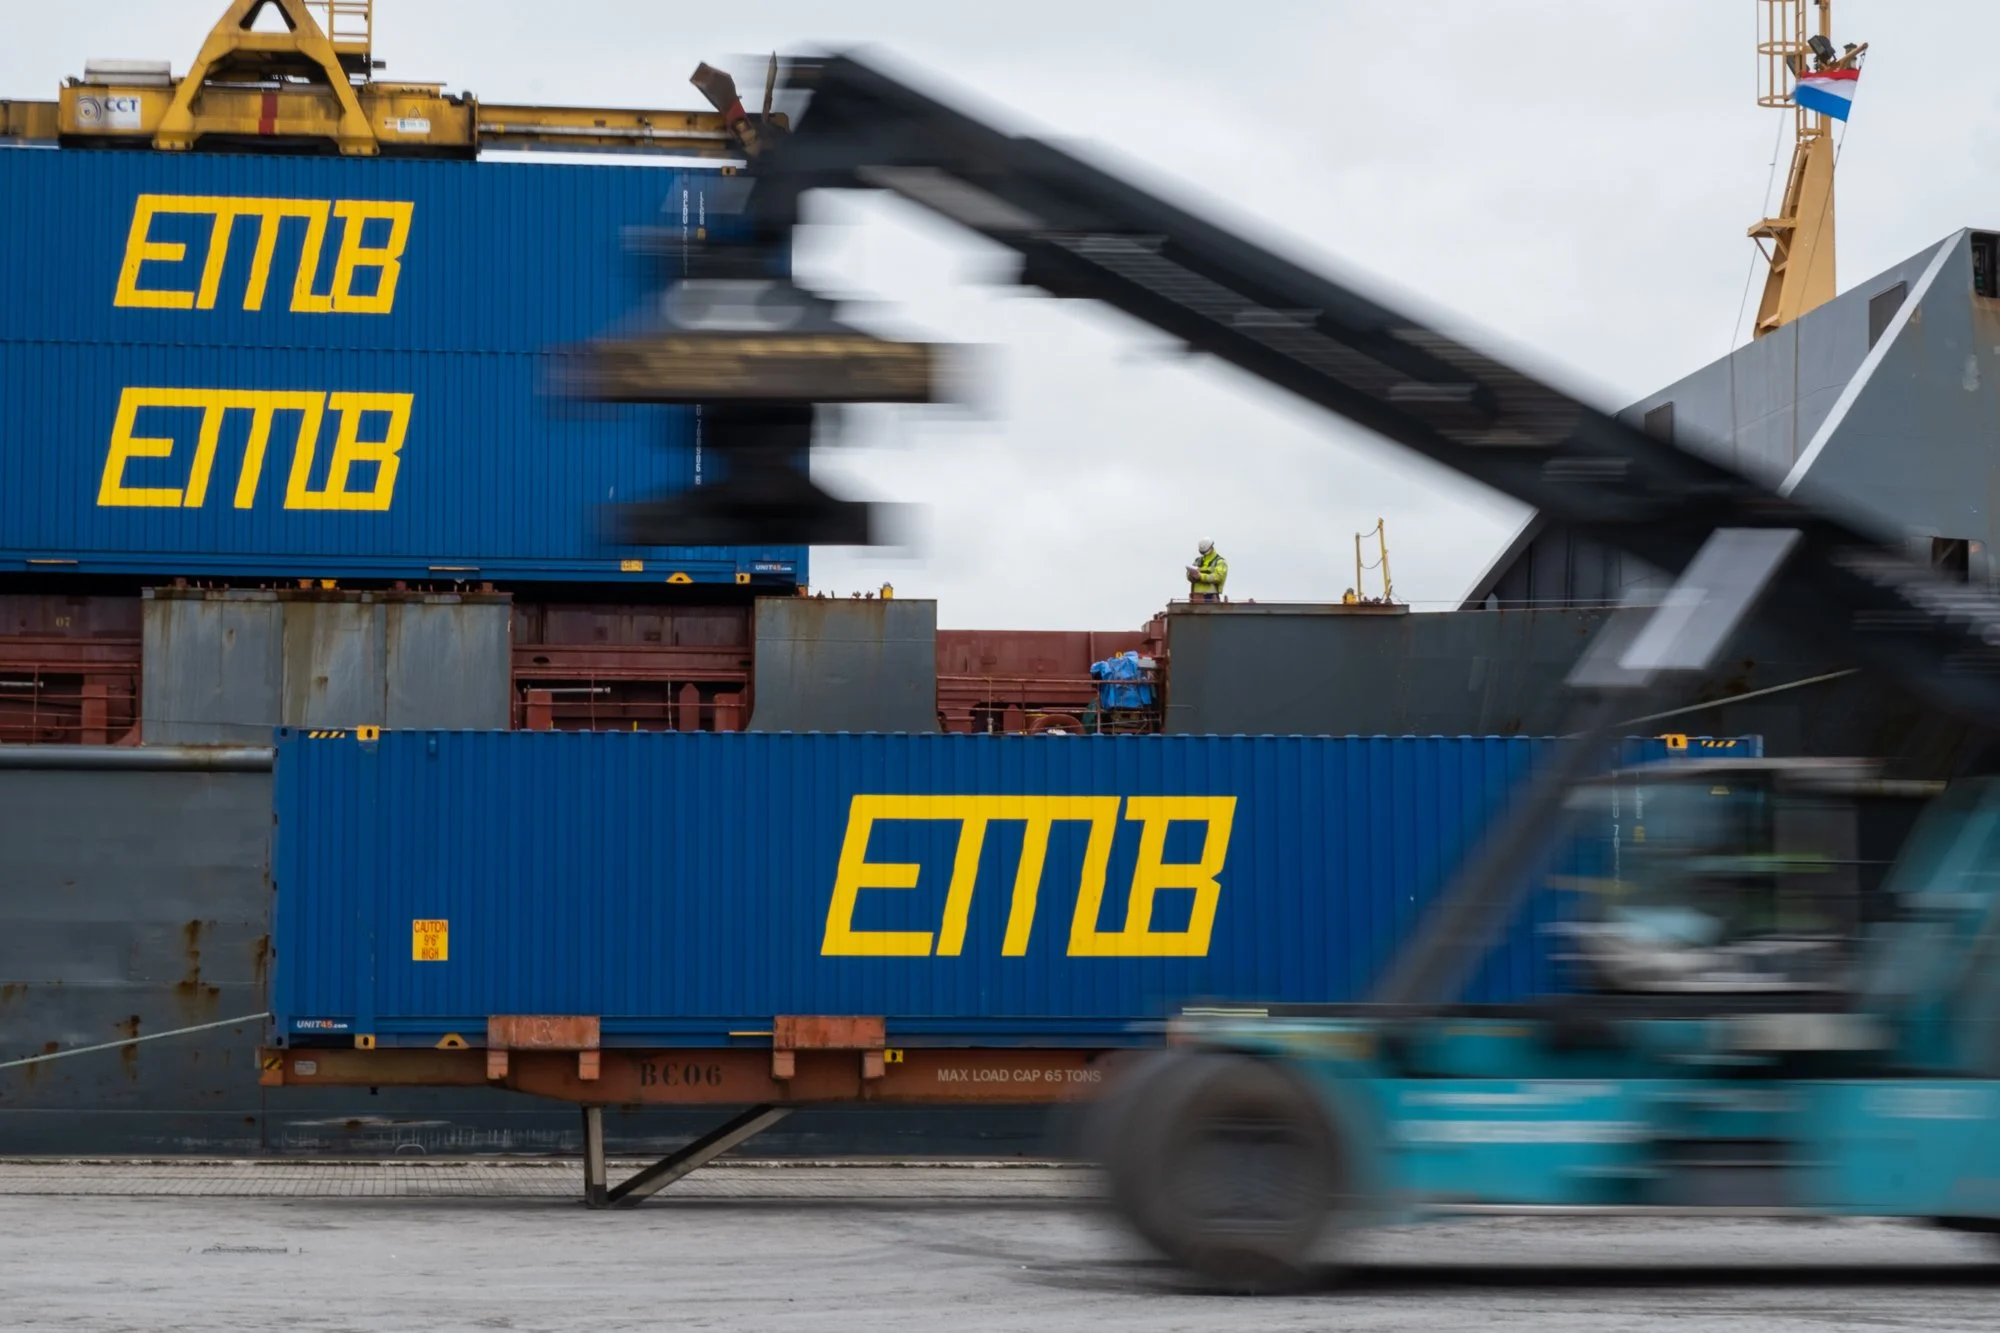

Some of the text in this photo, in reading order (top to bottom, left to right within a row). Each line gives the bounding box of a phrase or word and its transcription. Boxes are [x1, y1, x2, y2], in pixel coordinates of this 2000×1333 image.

[104, 97, 138, 112] CCT
[113, 194, 414, 314] EMB
[97, 387, 414, 511] EMB
[820, 795, 1237, 957] EMB
[414, 920, 448, 933] CAUTION
[421, 947, 439, 960] HIGH
[297, 1020, 348, 1029] UNIT45.com
[937, 1069, 1101, 1082] MAX LOAD CAP 65 TONS
